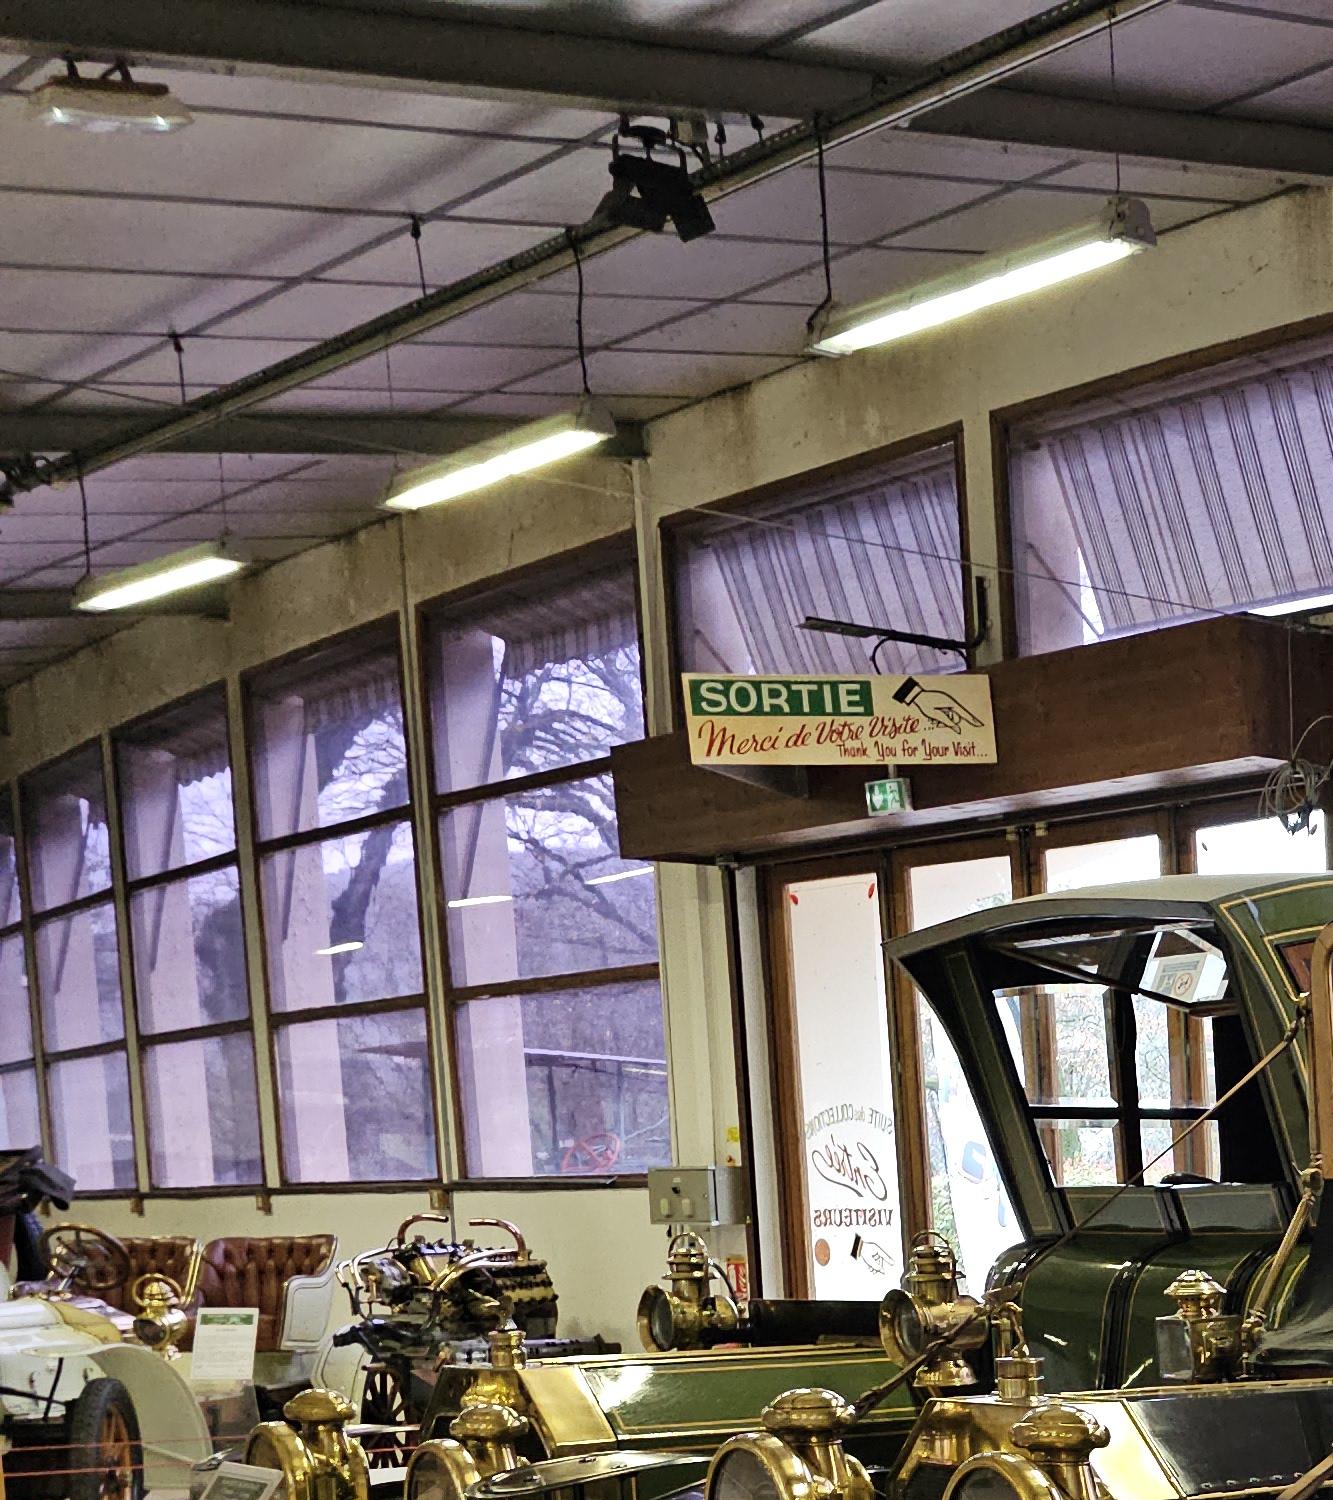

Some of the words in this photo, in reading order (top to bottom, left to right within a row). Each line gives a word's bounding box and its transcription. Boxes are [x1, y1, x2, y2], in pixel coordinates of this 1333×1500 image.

[699, 682, 865, 714] SORTIE
[698, 719, 784, 757] Merci
[784, 726, 812, 749] de
[815, 719, 863, 744] Votre
[869, 716, 920, 738] Visite
[836, 743, 871, 759] Thank
[874, 742, 897, 762] You
[901, 741, 918, 757] for
[922, 739, 949, 761] Your
